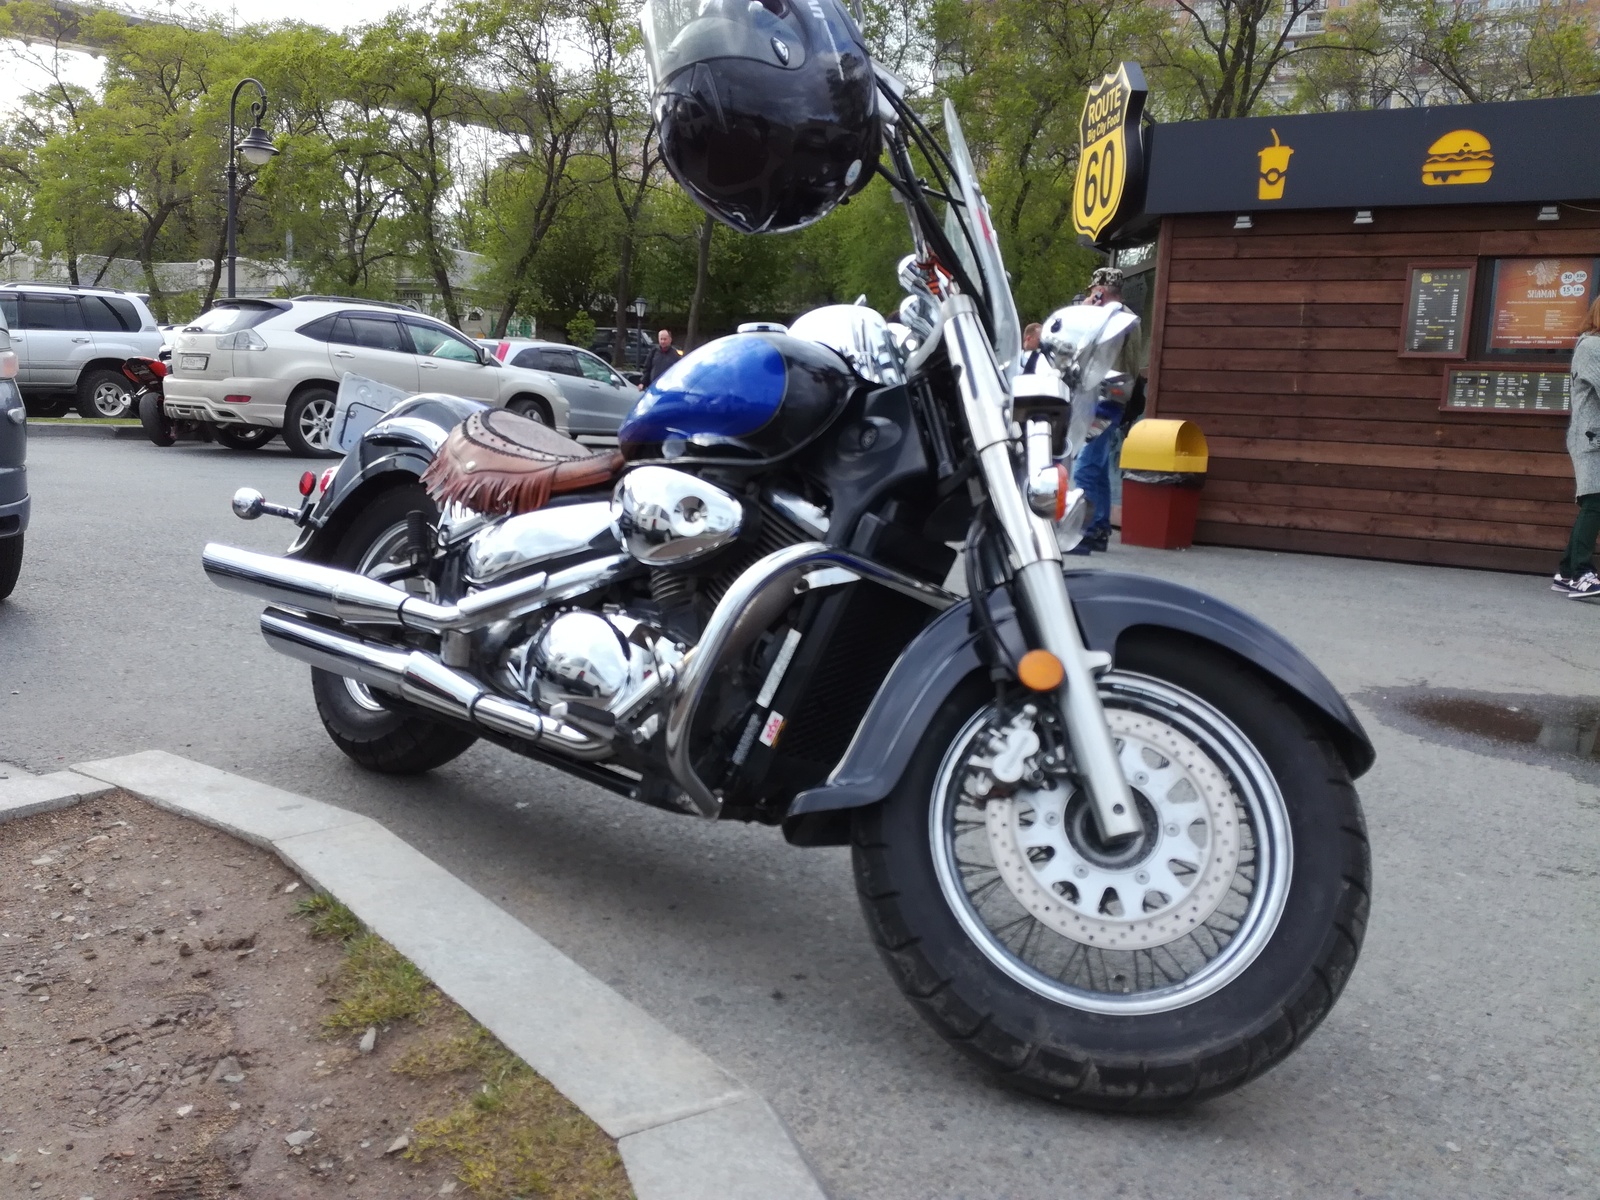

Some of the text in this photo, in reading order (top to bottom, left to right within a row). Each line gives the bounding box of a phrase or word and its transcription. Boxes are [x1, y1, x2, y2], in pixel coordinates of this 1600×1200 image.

[1088, 82, 1121, 126] ROUTE
[1087, 108, 1120, 143] Big City Food
[1084, 139, 1114, 217] 60
[1527, 289, 1557, 298] SHAMAN
